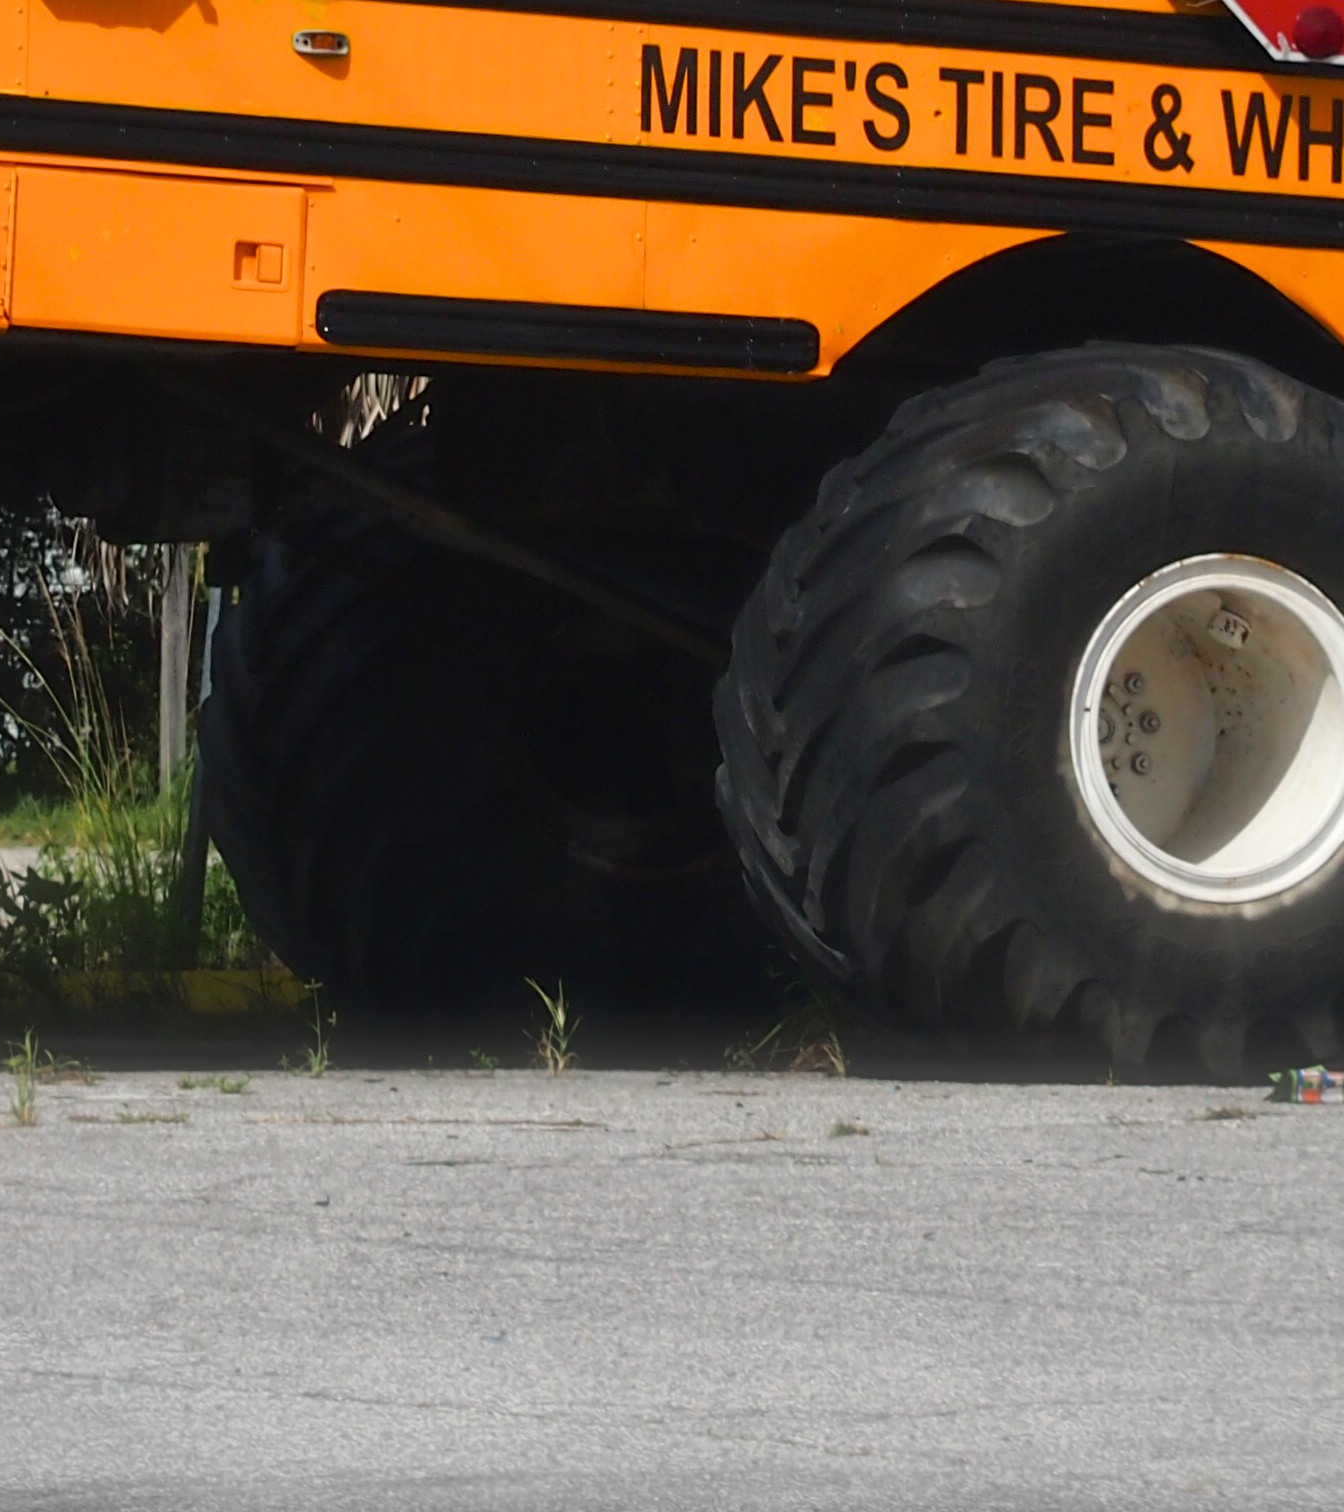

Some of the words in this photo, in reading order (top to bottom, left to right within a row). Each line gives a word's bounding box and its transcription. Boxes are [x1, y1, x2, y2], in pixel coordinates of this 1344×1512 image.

[639, 43, 910, 152] MIKE'S
[939, 67, 1115, 166] TIRE
[1143, 83, 1195, 174] &
